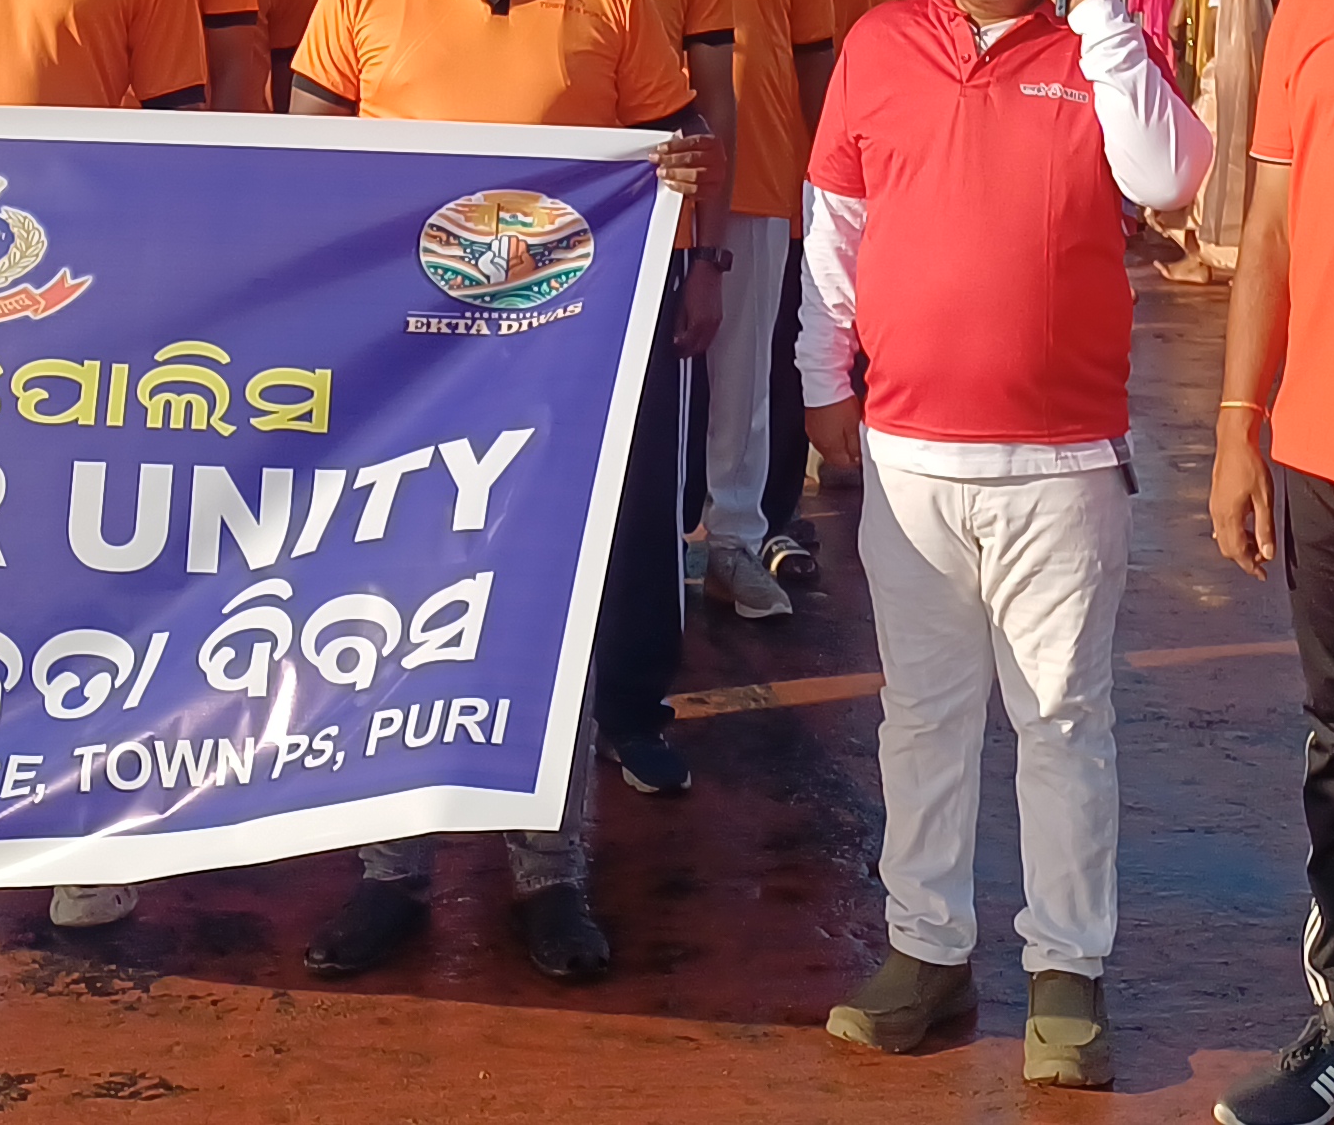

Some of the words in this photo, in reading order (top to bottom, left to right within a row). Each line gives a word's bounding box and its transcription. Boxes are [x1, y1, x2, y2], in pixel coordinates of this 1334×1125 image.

[406, 317, 491, 335] EKTA
[497, 301, 583, 335] DIWAS
[68, 427, 536, 573] UNITY
[198, 571, 494, 697] ଦିବସ
[74, 737, 256, 793] TOWN
[271, 725, 345, 780] PS,
[365, 697, 511, 757] PURI
